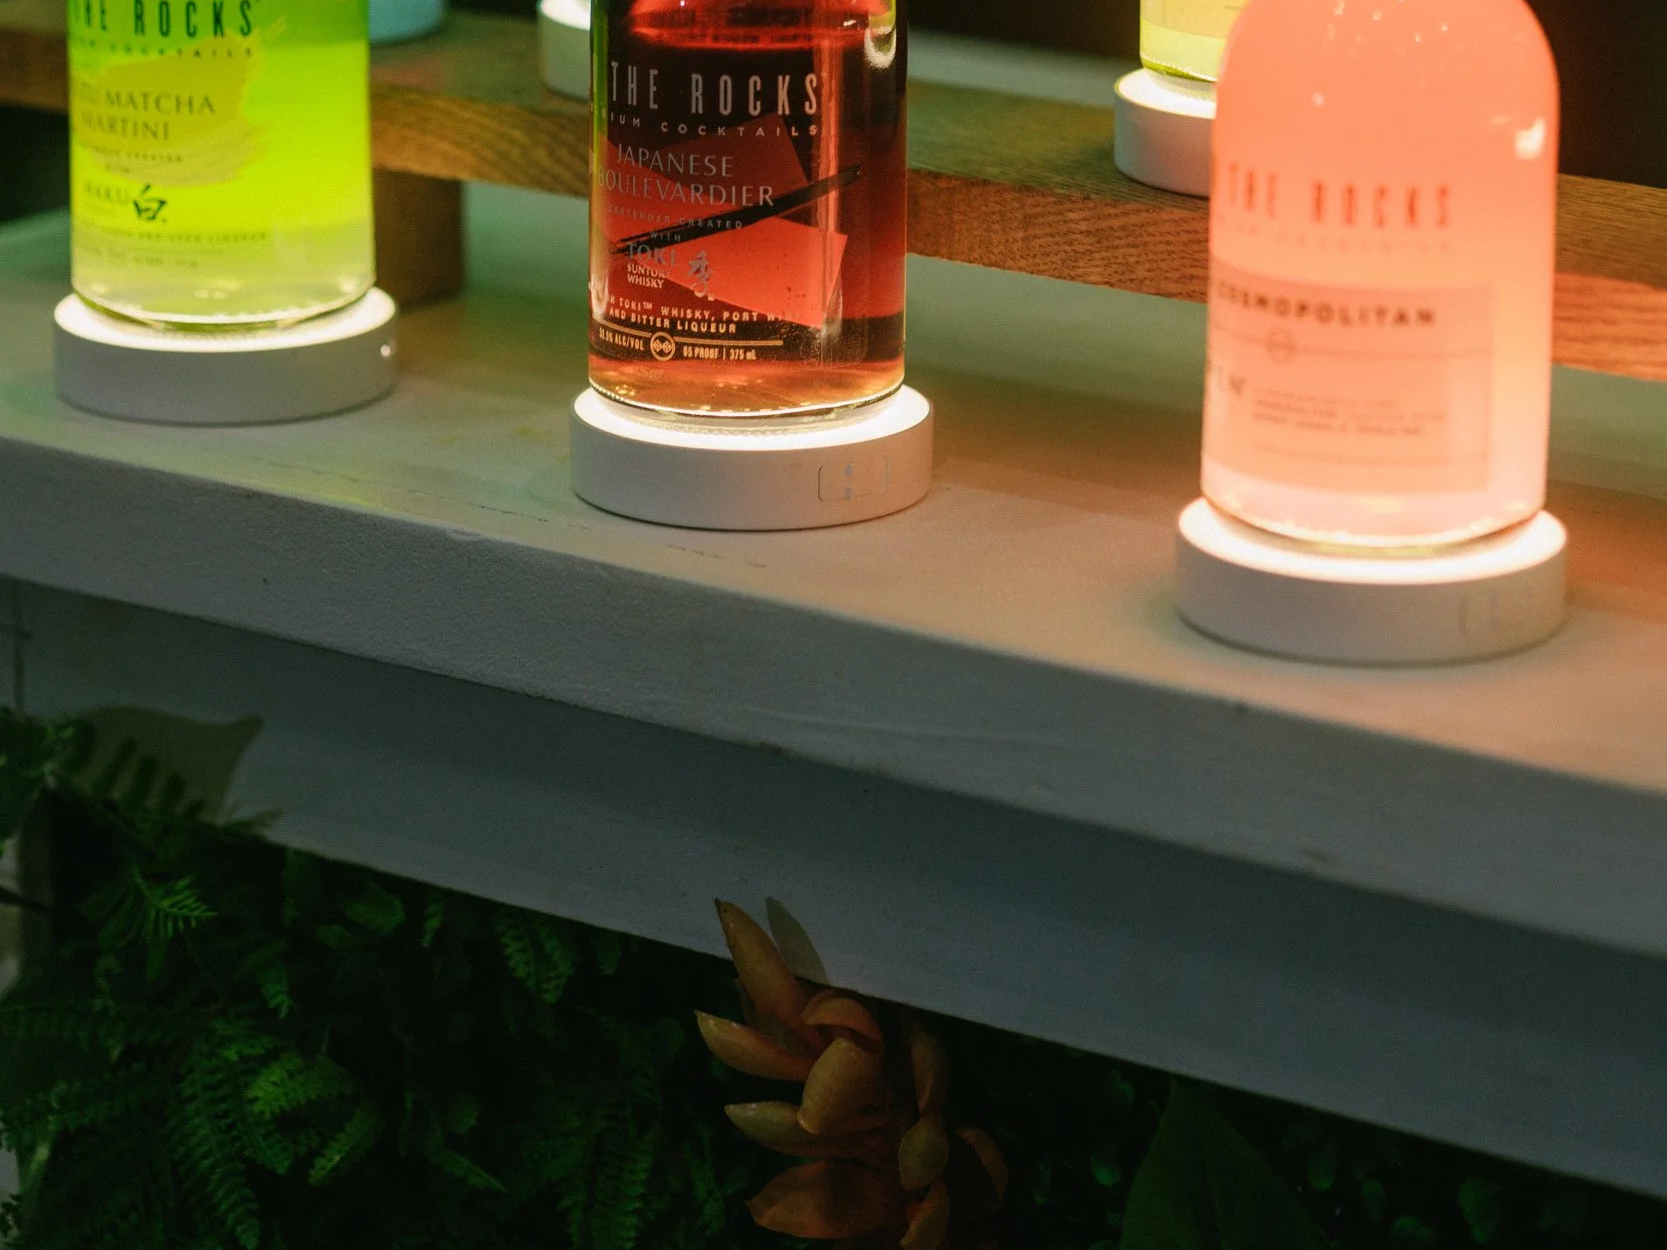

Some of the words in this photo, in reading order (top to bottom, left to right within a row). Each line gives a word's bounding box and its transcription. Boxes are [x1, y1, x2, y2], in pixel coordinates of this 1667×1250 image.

[611, 60, 659, 110] THE
[691, 73, 819, 117] ROCKS
[105, 90, 216, 115] MATCHA
[660, 121, 818, 137] COCKTAILS
[617, 143, 734, 178] JAPANESE
[598, 165, 774, 207] BOULEVARDIER
[651, 231, 682, 243] WITH
[627, 273, 665, 290] WHISKY
[609, 306, 627, 320] AND
[631, 312, 671, 330] BITTER
[676, 320, 738, 334] LIQUEUR
[722, 311, 759, 322] PORT
